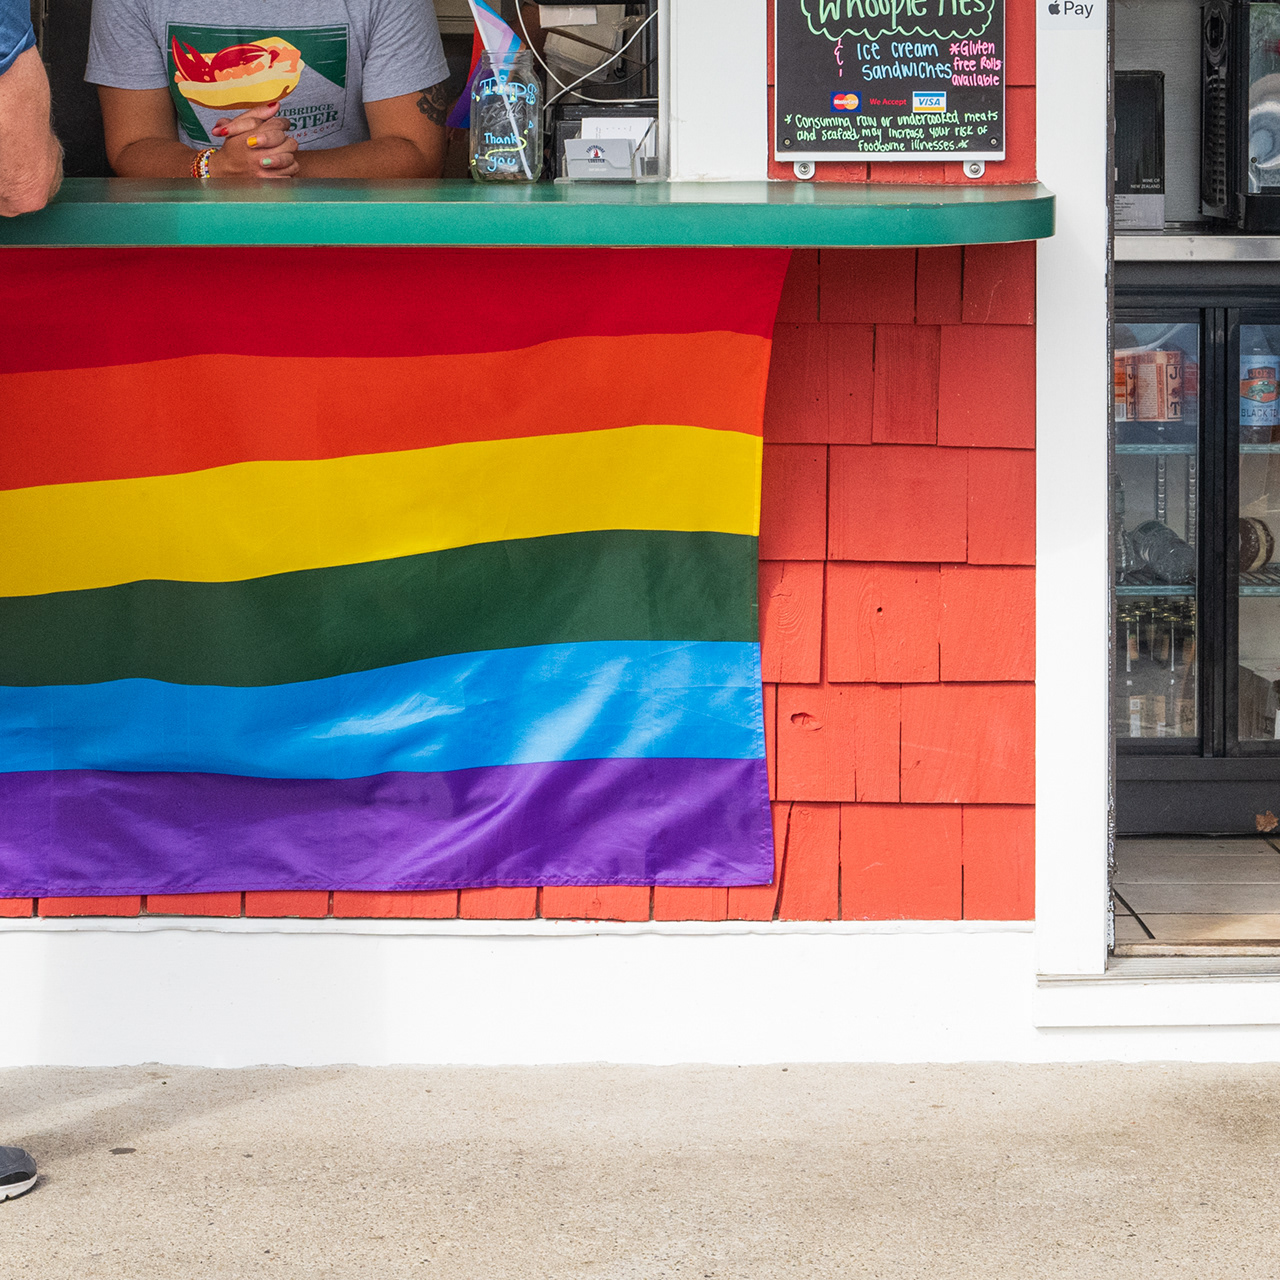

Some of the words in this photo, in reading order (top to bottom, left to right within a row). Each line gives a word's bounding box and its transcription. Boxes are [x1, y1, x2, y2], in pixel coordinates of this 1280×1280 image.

[1065, 1, 1093, 18] Pay
[857, 43, 880, 60] Ice
[891, 42, 938, 58] cream
[953, 59, 976, 71] free
[980, 57, 1001, 70] Rolls
[952, 74, 999, 86] available
[882, 98, 906, 106] Accept
[918, 98, 940, 106] VISA
[289, 111, 338, 131] STER
[484, 133, 518, 144] Thank
[487, 157, 516, 171] you
